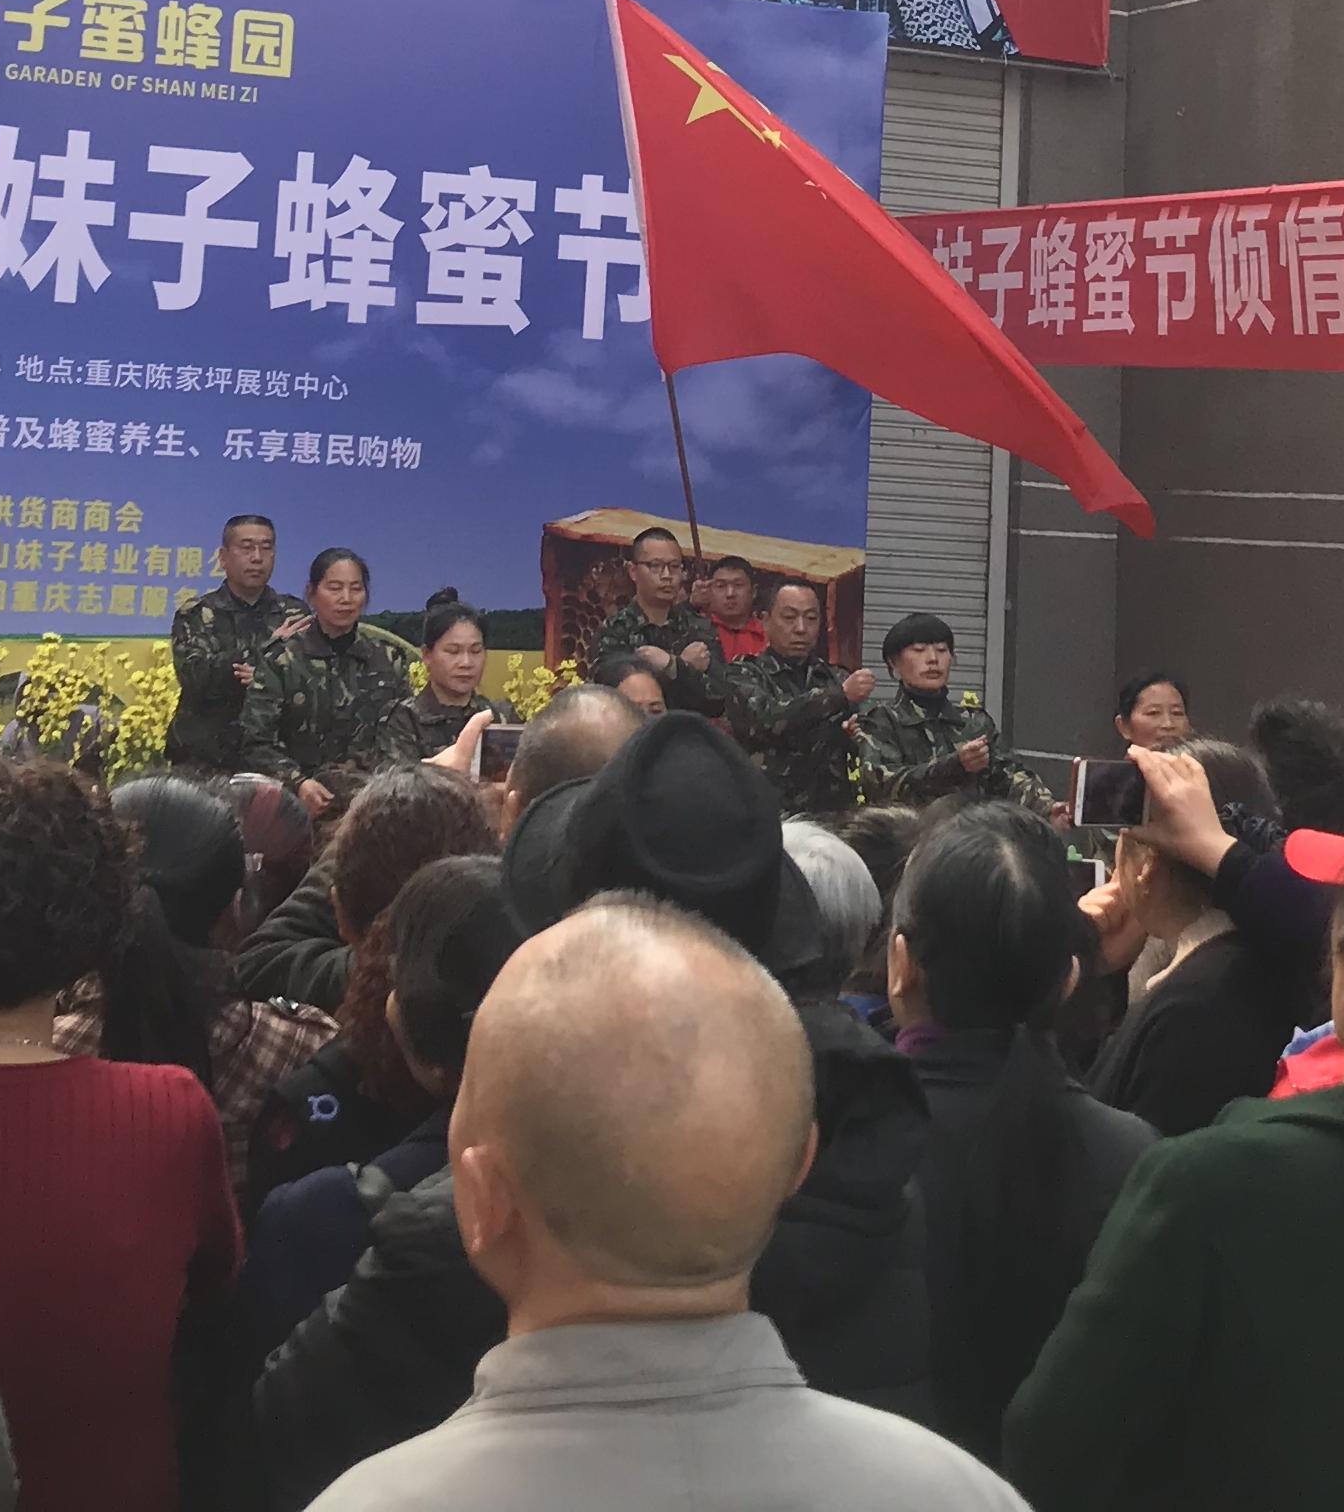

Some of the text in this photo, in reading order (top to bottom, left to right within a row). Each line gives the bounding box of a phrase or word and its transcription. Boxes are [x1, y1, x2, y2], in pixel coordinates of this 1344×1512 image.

[5, 62, 102, 89] GARADEN
[110, 73, 137, 91] OF
[142, 76, 197, 98] SHAN
[200, 82, 235, 101] MEI
[239, 86, 259, 104] ZI
